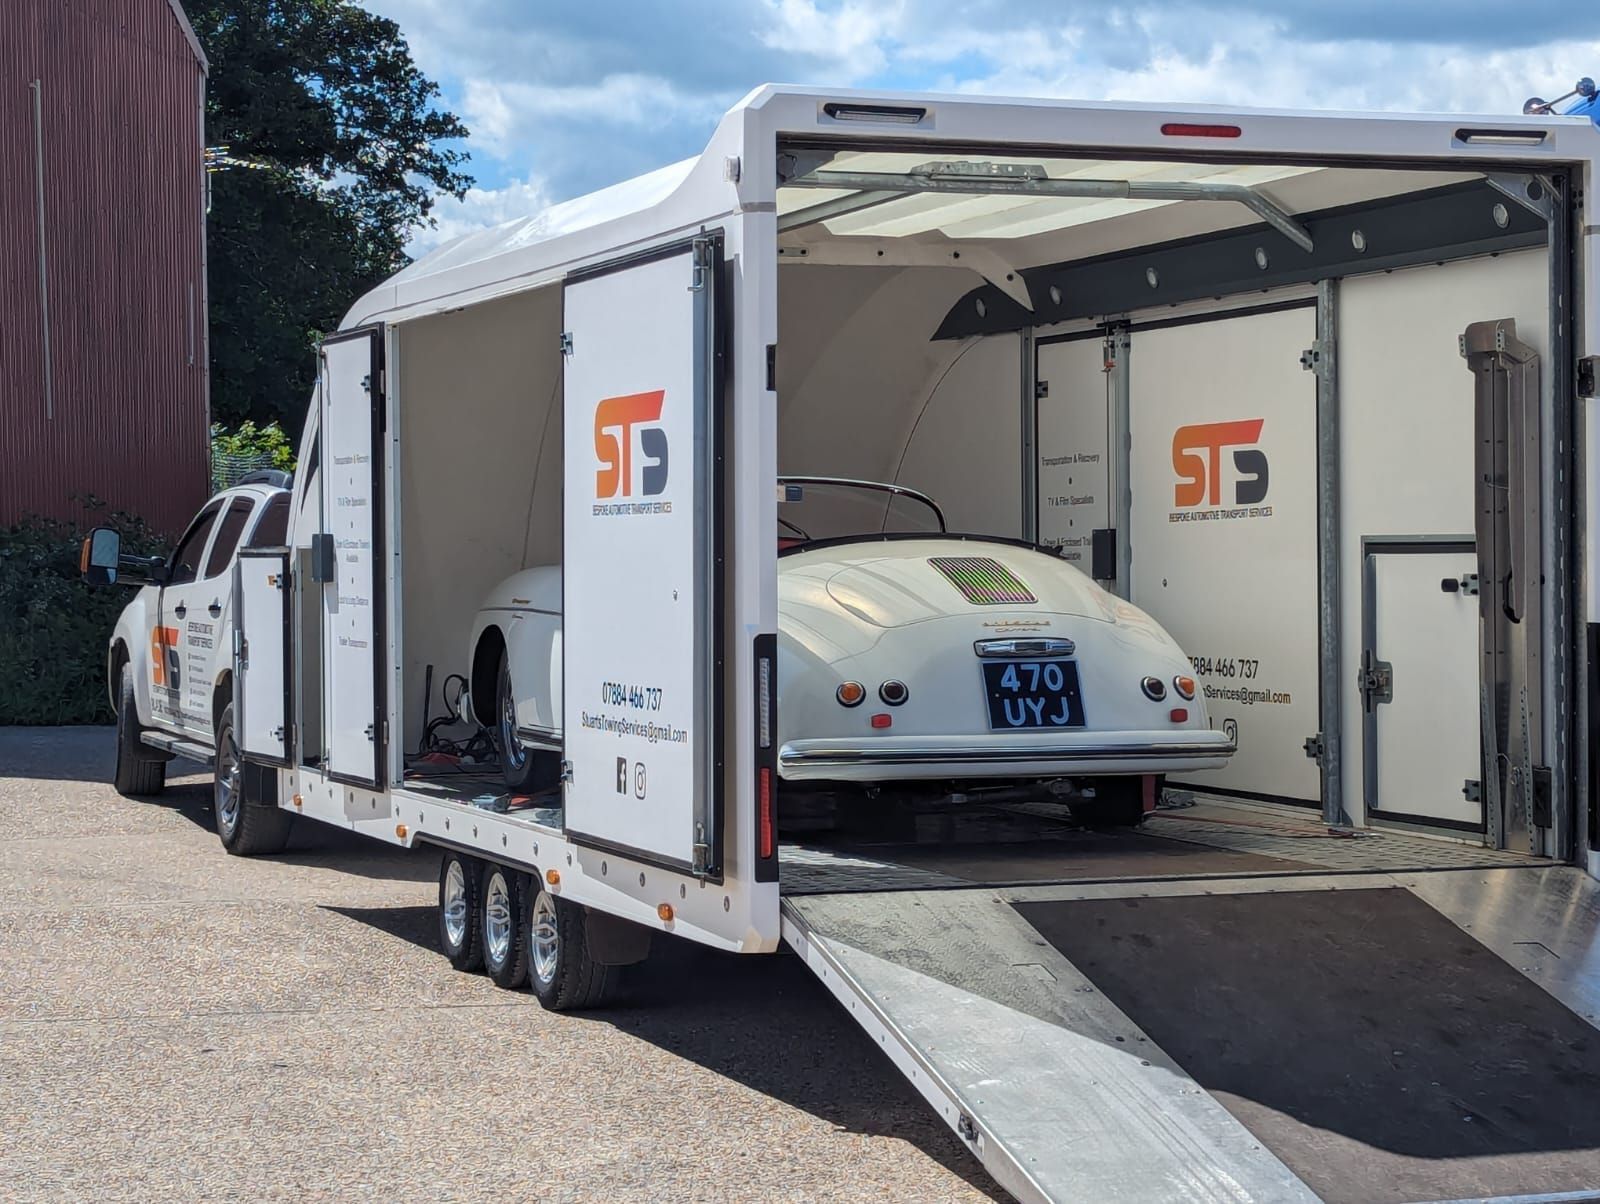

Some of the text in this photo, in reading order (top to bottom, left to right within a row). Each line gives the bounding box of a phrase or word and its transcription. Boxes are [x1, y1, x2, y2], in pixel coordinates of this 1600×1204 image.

[1041, 456, 1073, 466] Transportation
[1078, 453, 1100, 464] Recovery
[1047, 497, 1055, 507] TV
[1248, 506, 1273, 518] SERVICES
[1001, 664, 1064, 691] 470
[1215, 659, 1236, 678] 466
[1238, 660, 1259, 679] 737
[602, 682, 662, 712] 07884 466 737
[582, 711, 688, 743] StuartsTowingServices@gmail.com
